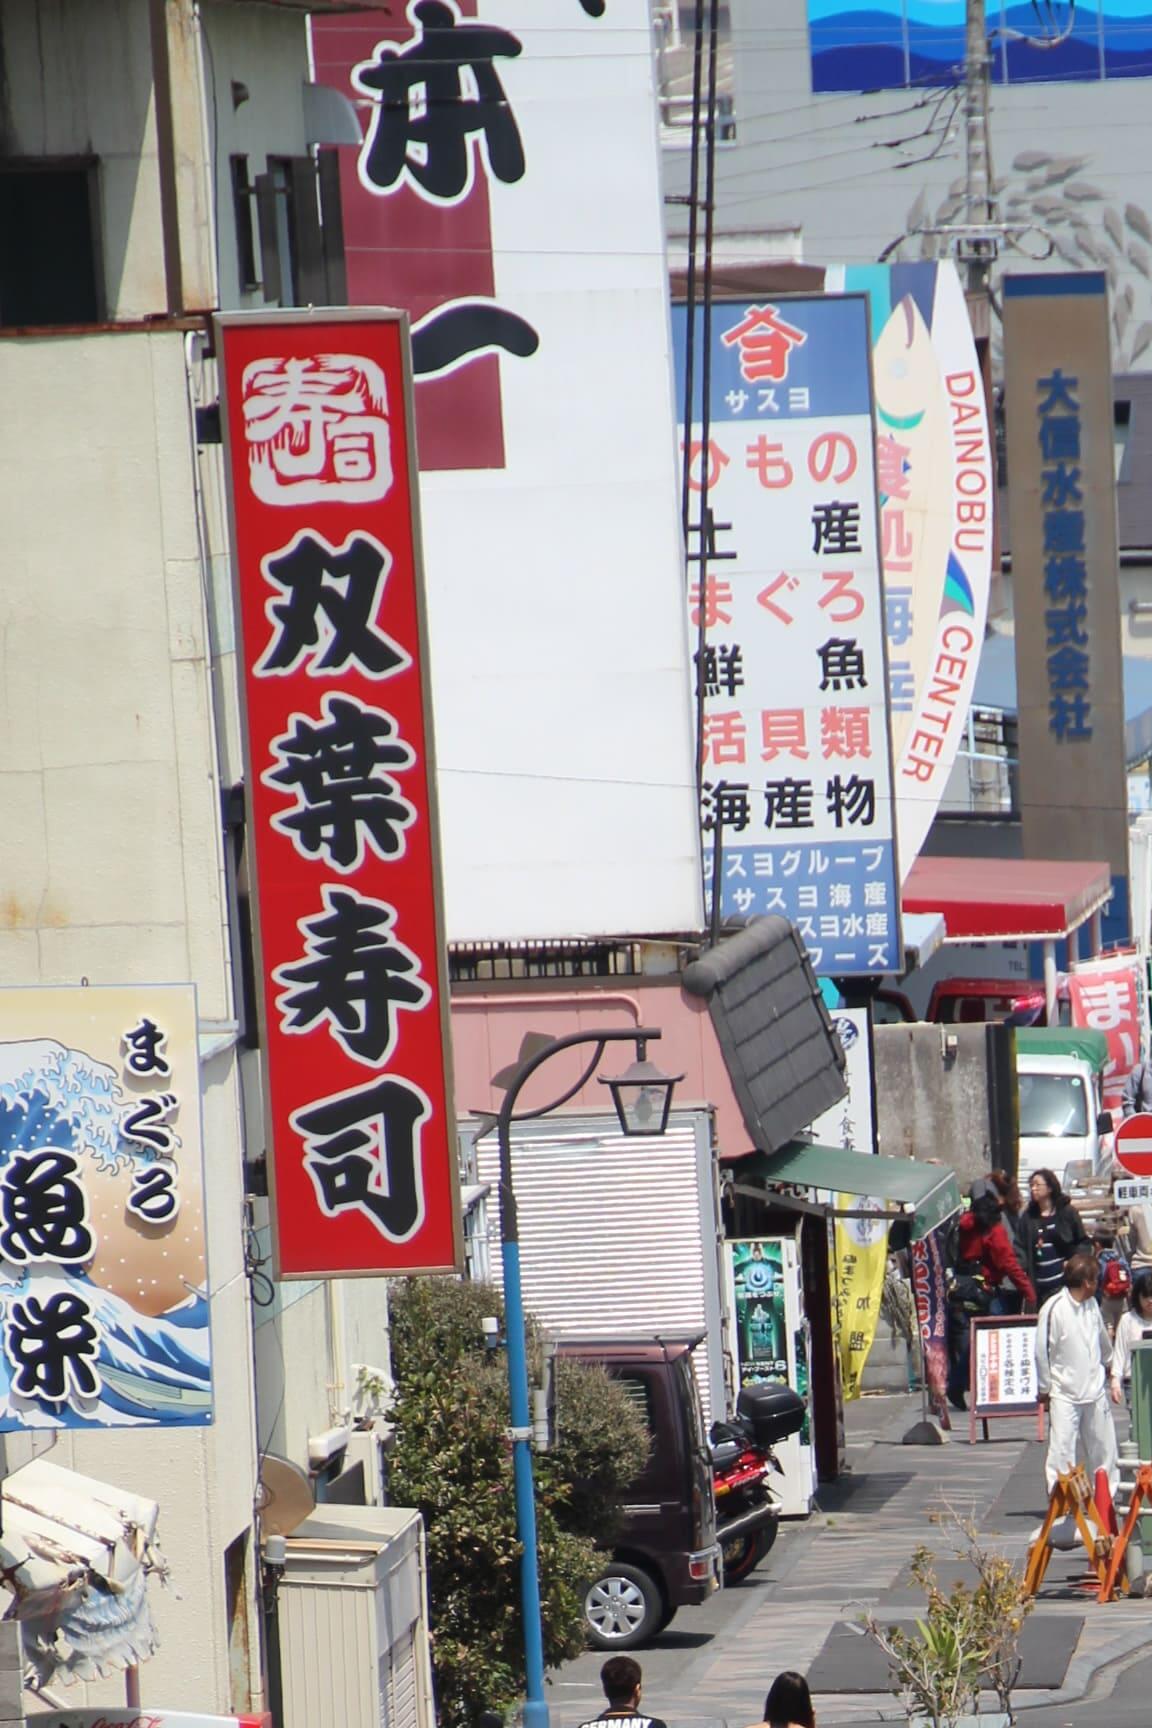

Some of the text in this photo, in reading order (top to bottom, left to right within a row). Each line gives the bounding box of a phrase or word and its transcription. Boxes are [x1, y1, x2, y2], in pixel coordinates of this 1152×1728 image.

[725, 388, 810, 415] サスヨ
[680, 432, 858, 493] ひもの
[945, 370, 987, 553] DAINOBU
[688, 571, 865, 629] まぐろ
[1036, 367, 1093, 742] 大信水産株式会社
[702, 706, 872, 766] 活貝類
[902, 625, 973, 783] CENTER
[701, 774, 876, 832] 海産物
[254, 530, 431, 1243] 双葉寿司
[121, 1018, 179, 1223] まぐろ
